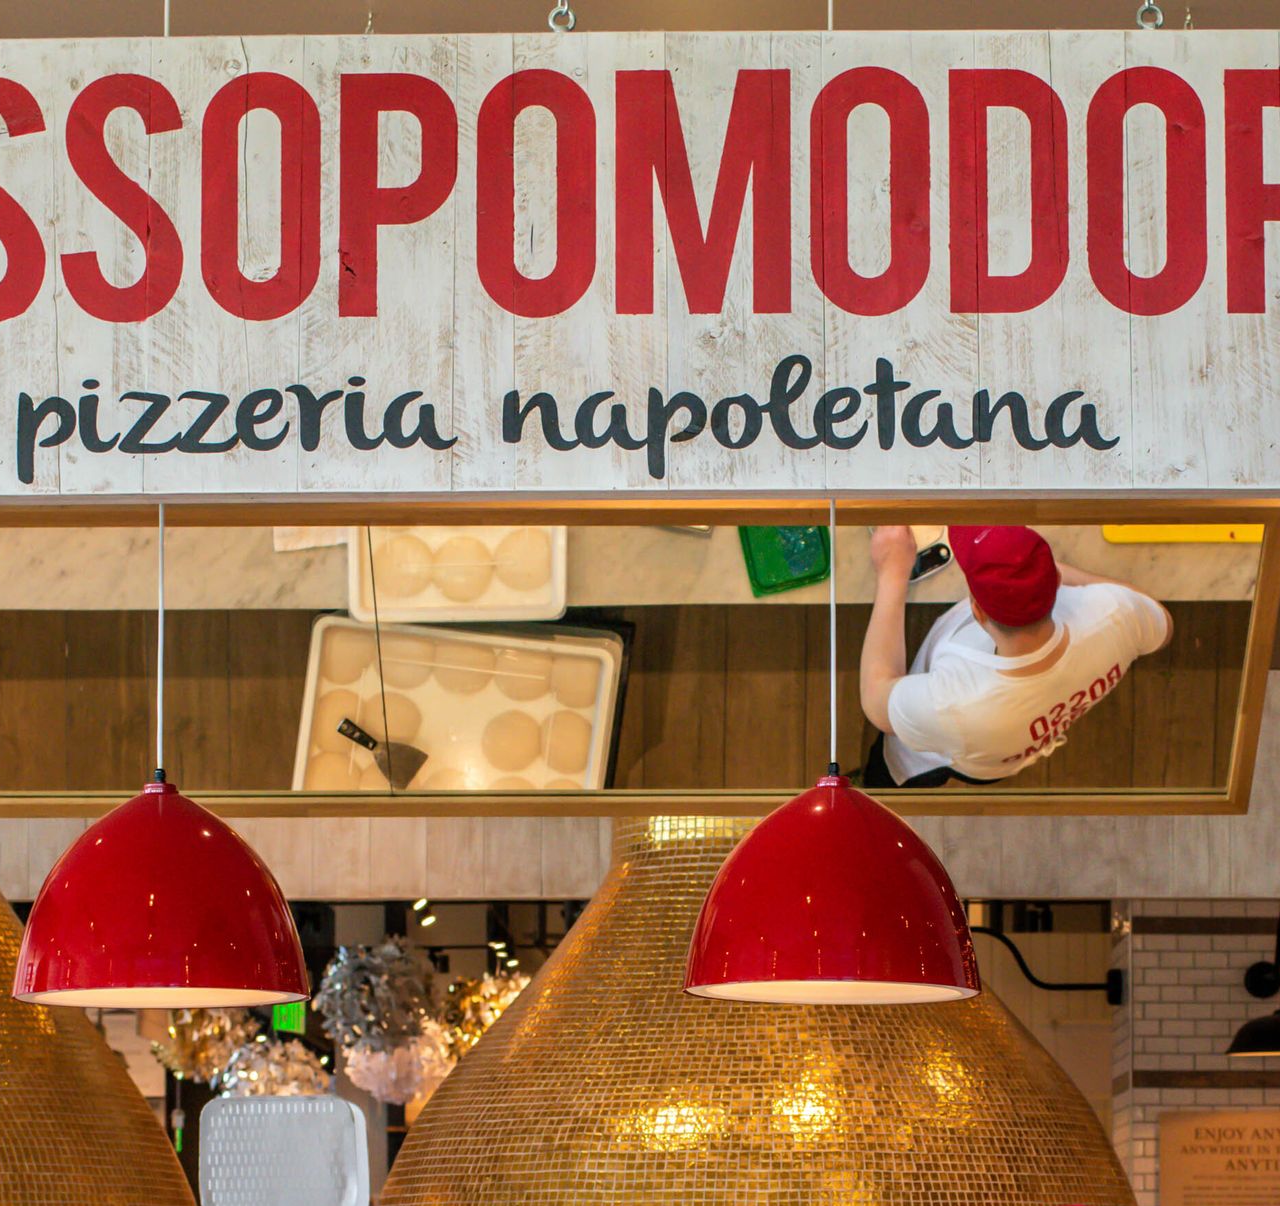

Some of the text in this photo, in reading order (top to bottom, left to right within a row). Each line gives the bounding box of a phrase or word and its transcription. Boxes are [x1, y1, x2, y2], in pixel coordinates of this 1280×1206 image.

[16, 353, 1118, 485] pizzeria napoletana
[1194, 1127, 1246, 1143] ENJOY
